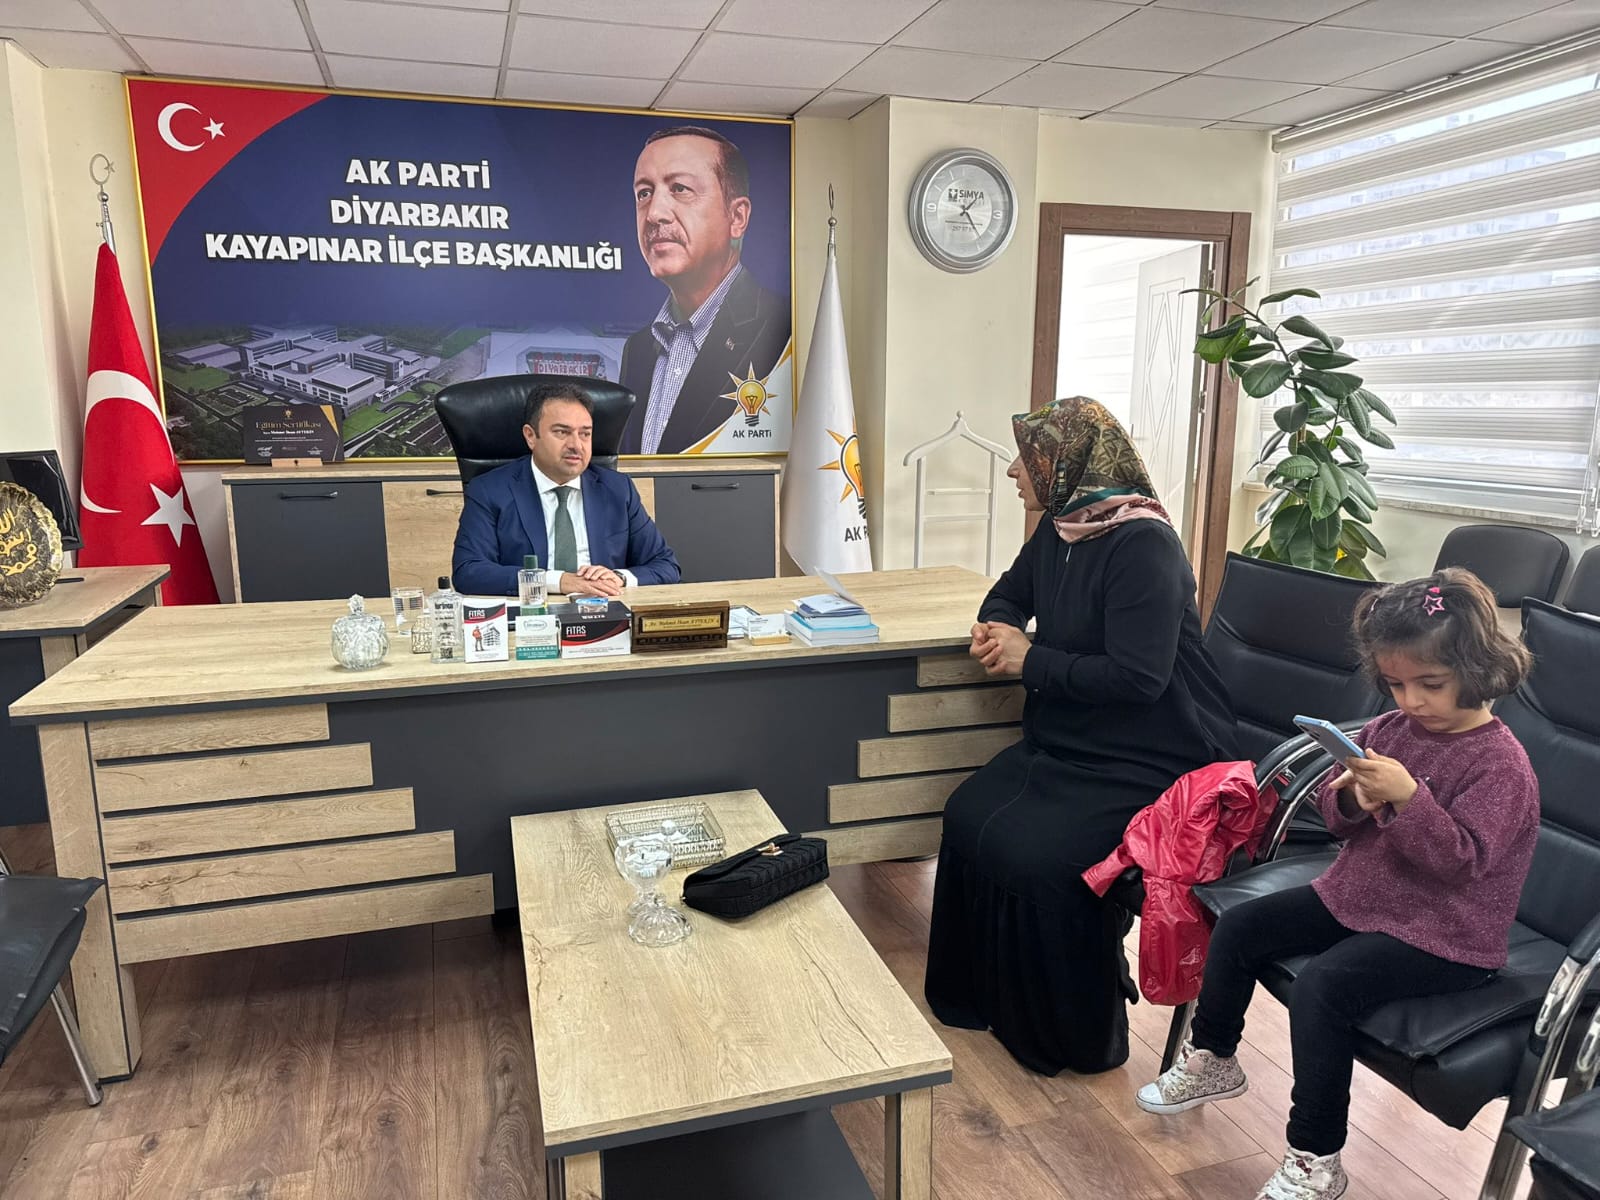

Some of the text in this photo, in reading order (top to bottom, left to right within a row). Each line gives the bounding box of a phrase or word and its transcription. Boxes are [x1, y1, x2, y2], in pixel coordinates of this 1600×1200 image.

[345, 158, 491, 190] AK PARTİ
[330, 195, 510, 230] DİYARBAKIR
[205, 233, 623, 271] KAYAPINAR İLÇE BAŞKANLIĞI
[732, 429, 745, 438] AK
[844, 525, 863, 543] AK
